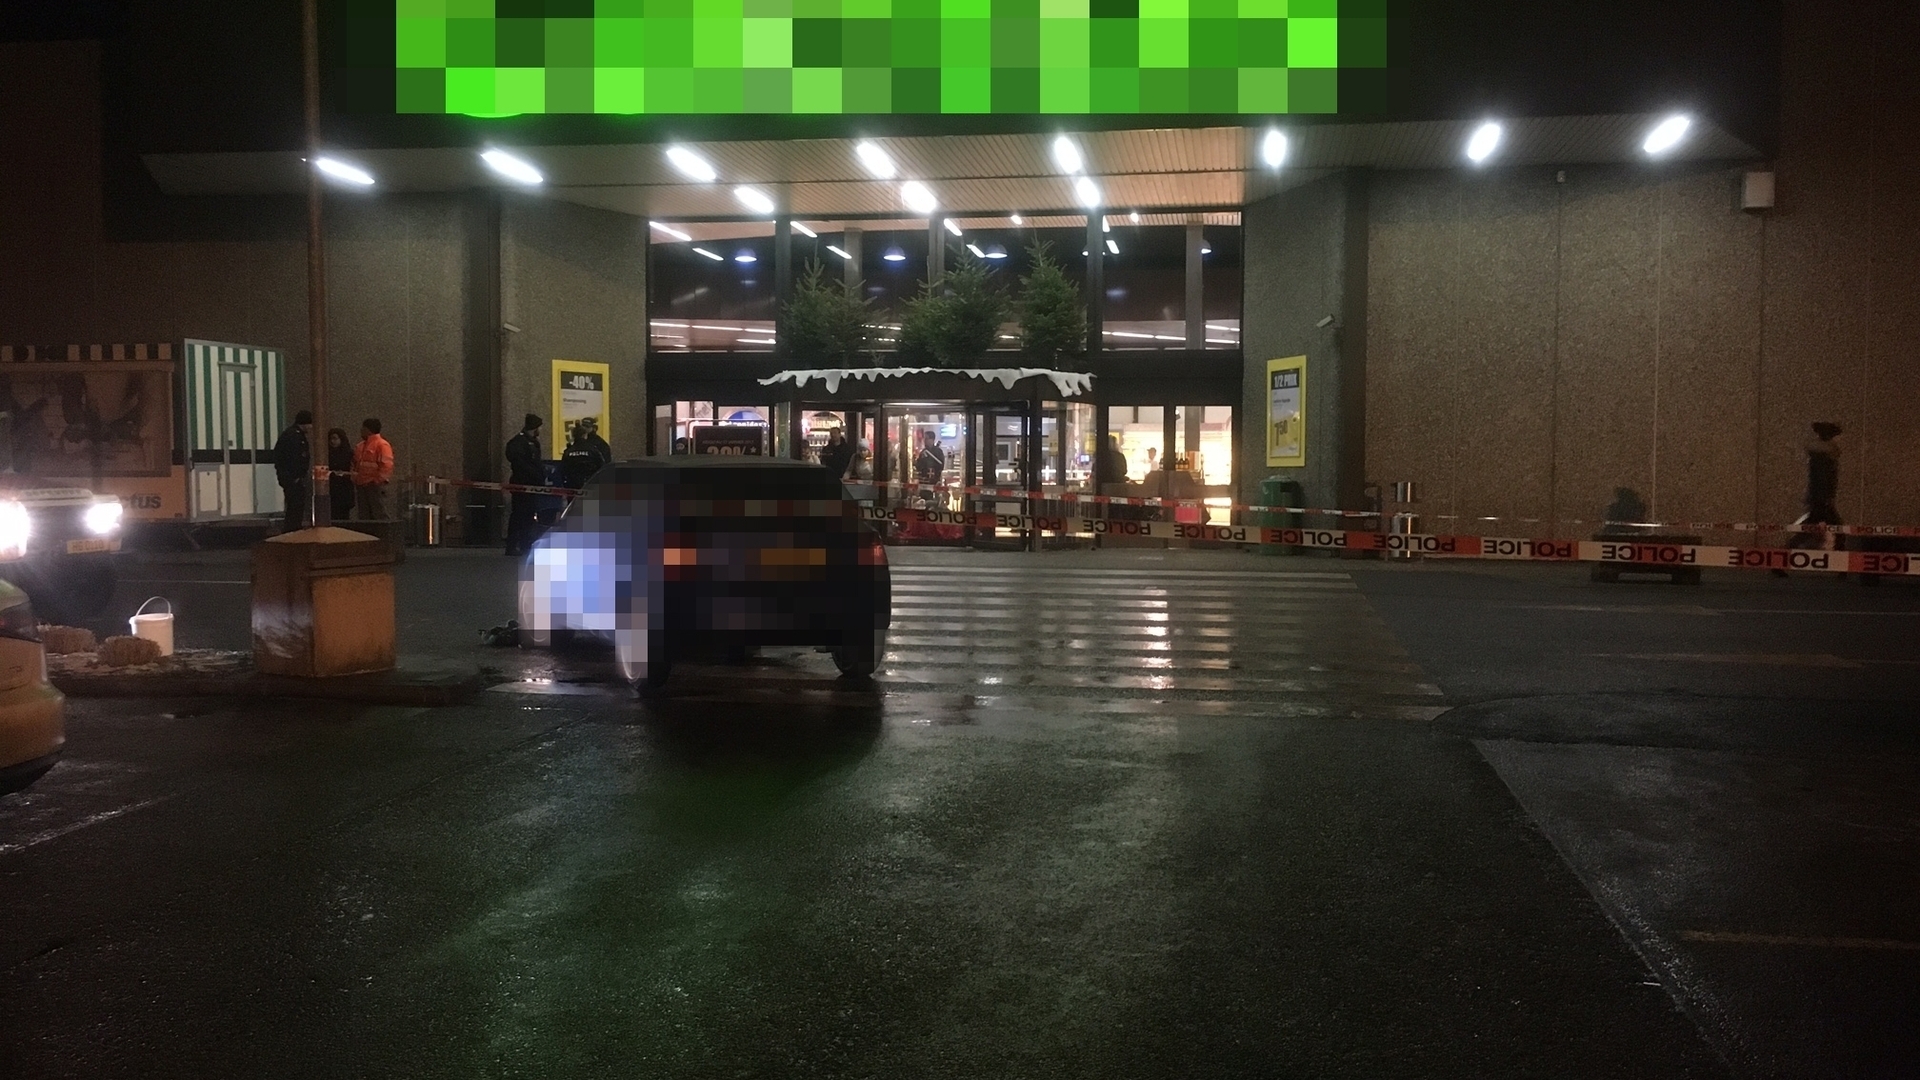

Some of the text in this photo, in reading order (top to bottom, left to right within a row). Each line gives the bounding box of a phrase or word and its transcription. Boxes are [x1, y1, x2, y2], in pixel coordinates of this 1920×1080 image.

[569, 375, 594, 390] -40%
[860, 506, 897, 520] POLI
[916, 510, 977, 525] POLICE
[997, 515, 1061, 530] POLICE
[1083, 519, 1151, 536] POLICE
[1857, 526, 1898, 534] POLICE
[1174, 524, 1246, 540] POLICE
[1270, 529, 1347, 546] POLICE
[1373, 534, 1455, 552] POLICE
[1484, 539, 1572, 558] POLICE
[1602, 545, 1696, 563] POLICE
[1727, 549, 1829, 569] POLICE
